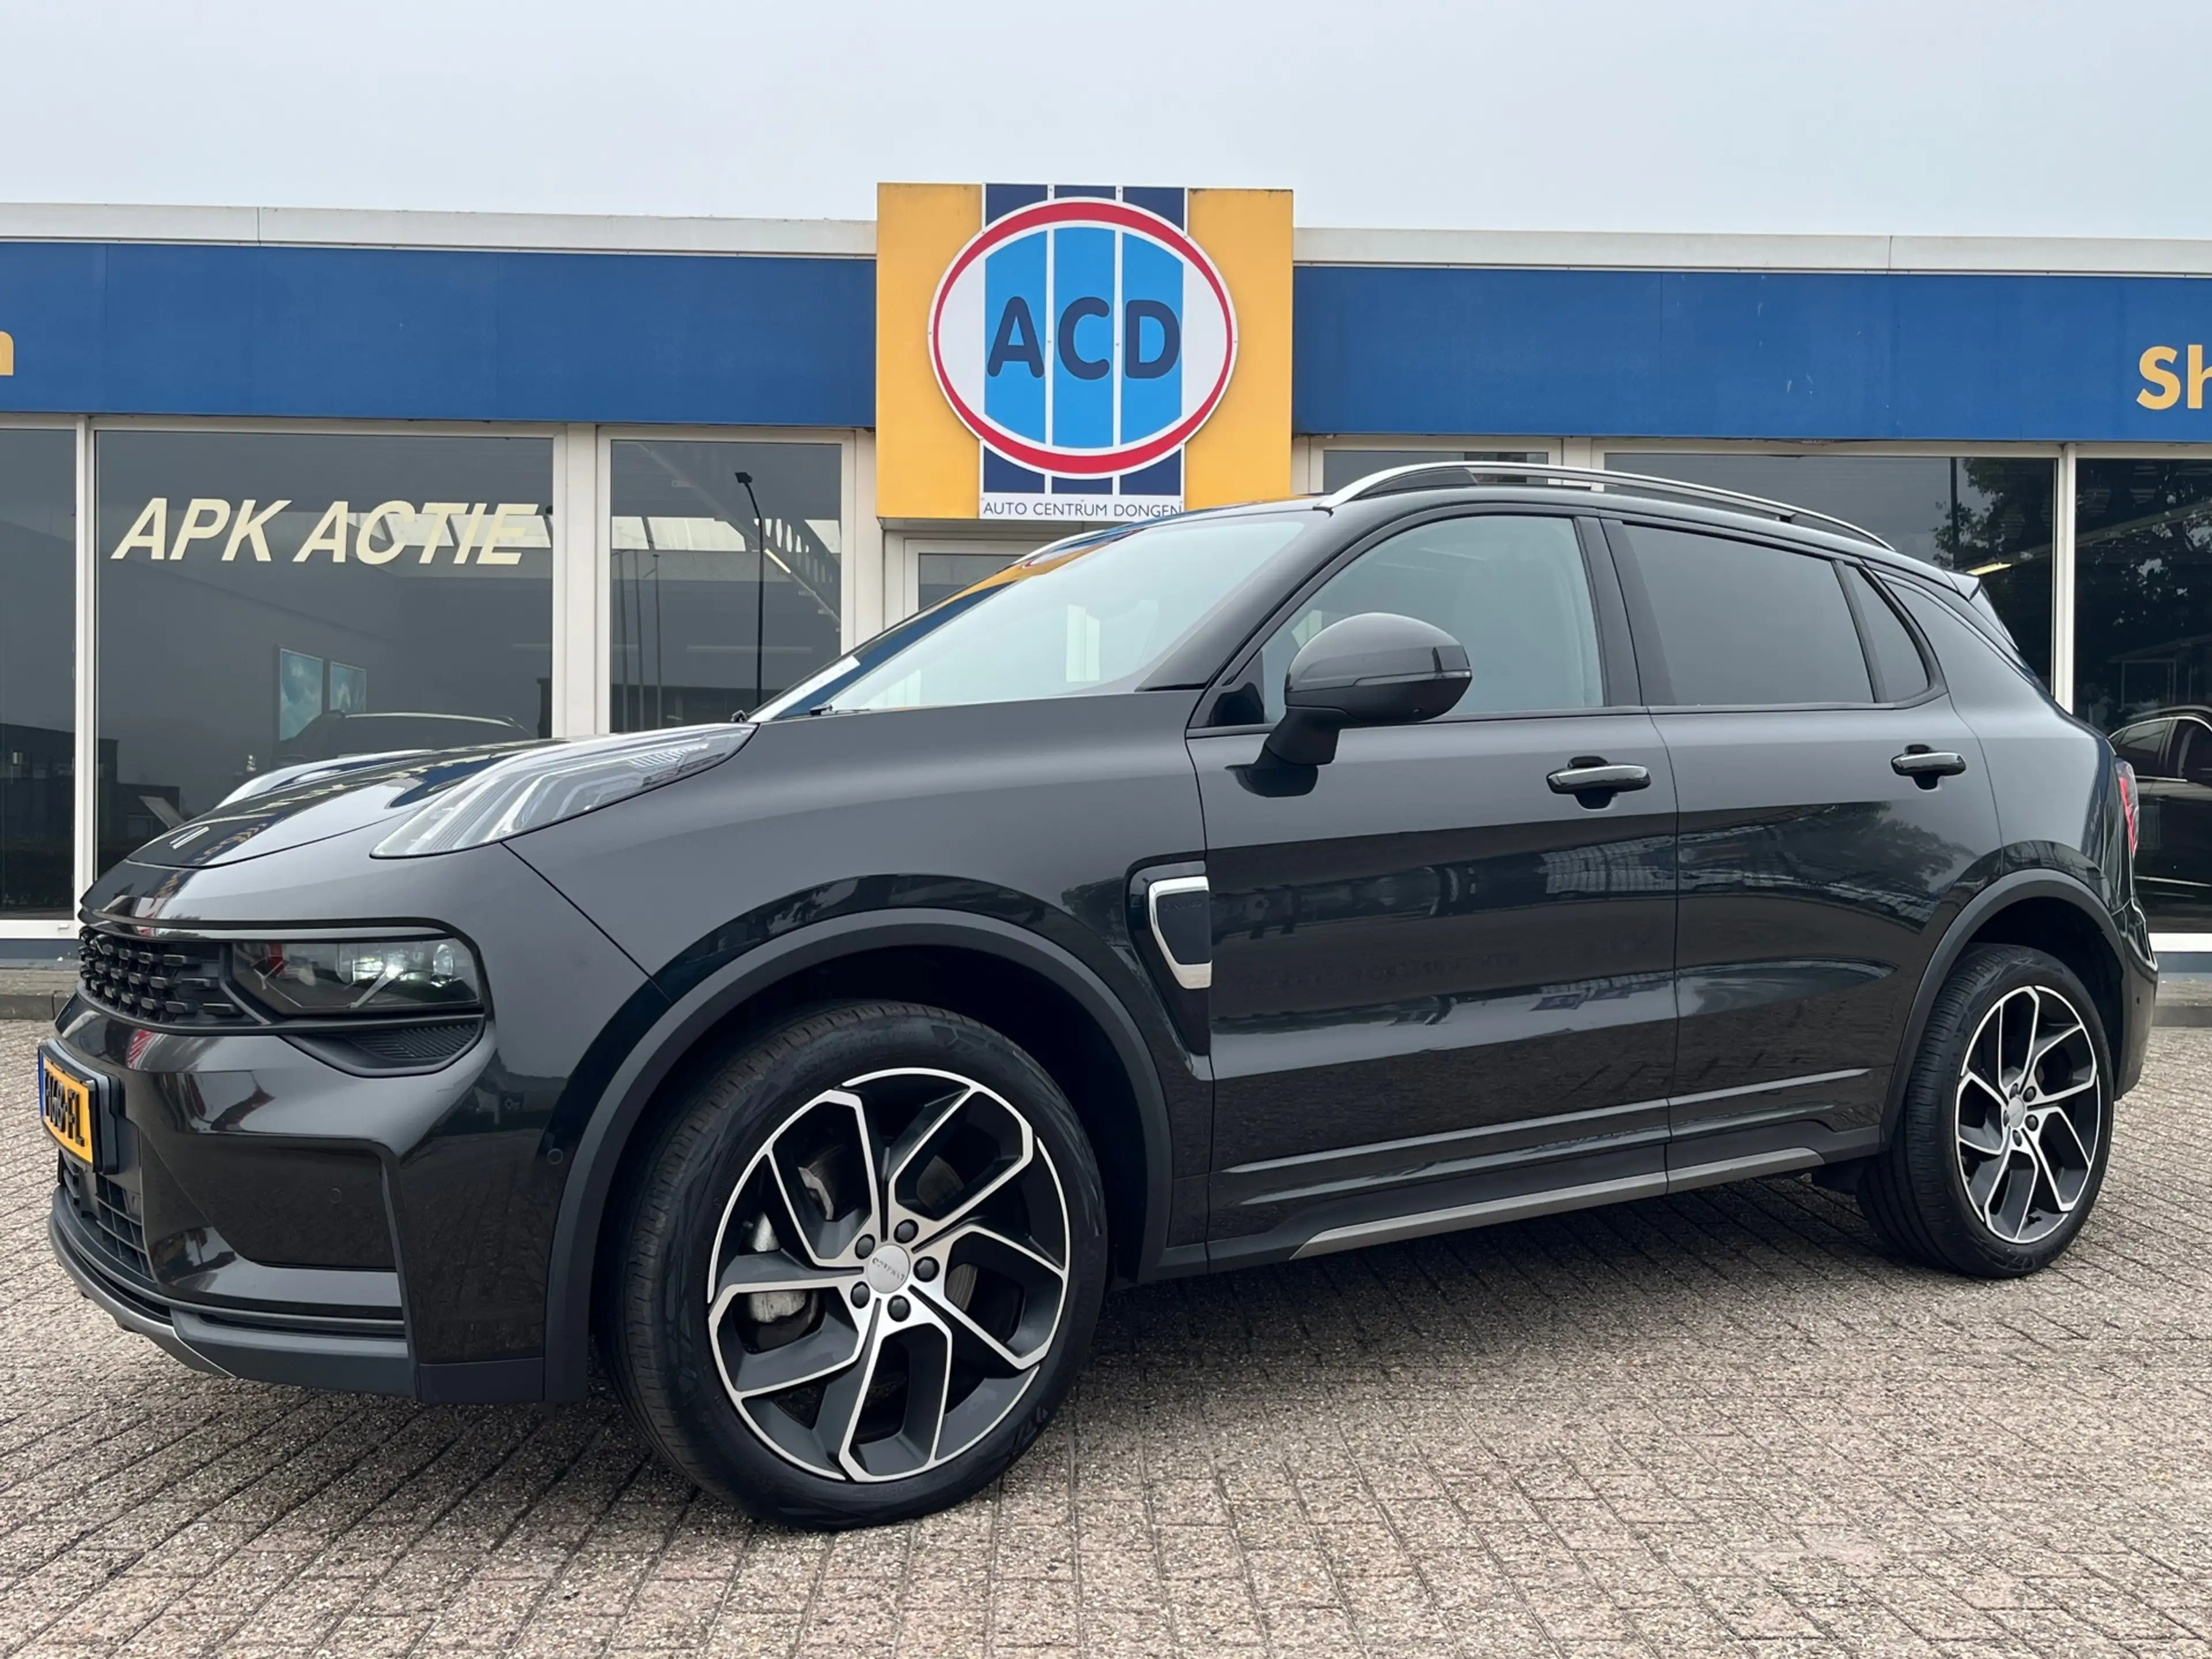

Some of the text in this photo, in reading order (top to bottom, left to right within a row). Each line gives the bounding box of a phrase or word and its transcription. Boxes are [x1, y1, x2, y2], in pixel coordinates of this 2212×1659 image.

[987, 296, 1181, 380] ACD
[111, 498, 539, 565] APK ACTIE
[983, 502, 1181, 517] AUTO CENTRUM DONGEN
